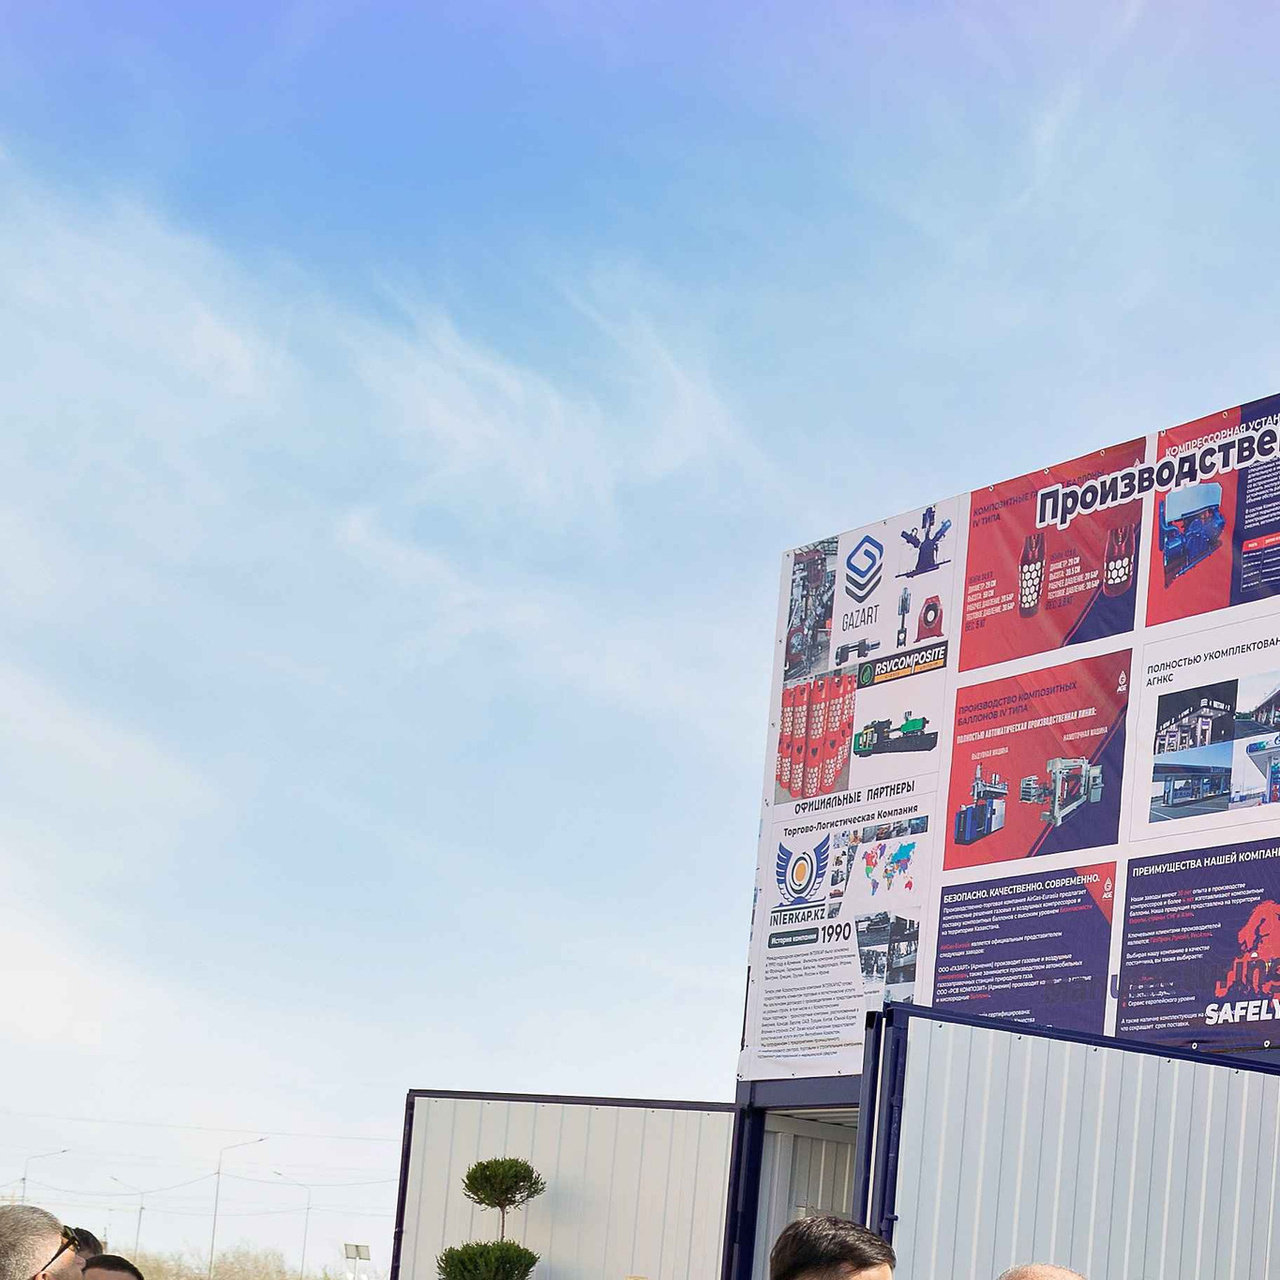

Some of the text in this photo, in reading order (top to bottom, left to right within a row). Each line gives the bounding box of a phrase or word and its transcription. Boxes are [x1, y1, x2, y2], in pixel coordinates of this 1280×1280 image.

[1165, 424, 1246, 457] КОМПРЕССОРНАЯ
[842, 604, 880, 632] GAZART
[875, 646, 945, 675] RSVCOMPOSITE
[1147, 654, 1202, 675] ПОЛНОСТЬЮ
[1146, 673, 1174, 687] АГНКС
[959, 694, 1017, 714] ПРОИЗВОДСТВО
[795, 780, 915, 815] ОФИЦИАЛЬНЫЕ ПАРТНЕРЫ
[784, 804, 918, 838] Торгово-Логистическая Компания
[1132, 858, 1203, 877] ПРЕИМУЩЕСТВА
[1204, 852, 1237, 868] НАШЕЙ
[944, 874, 1100, 903] БЕЗОПАСНО. КАЧЕСТВЕННО. СОВРЕМЕННО.
[770, 908, 825, 926] INTERKAP.KZ
[821, 922, 851, 943] 1990
